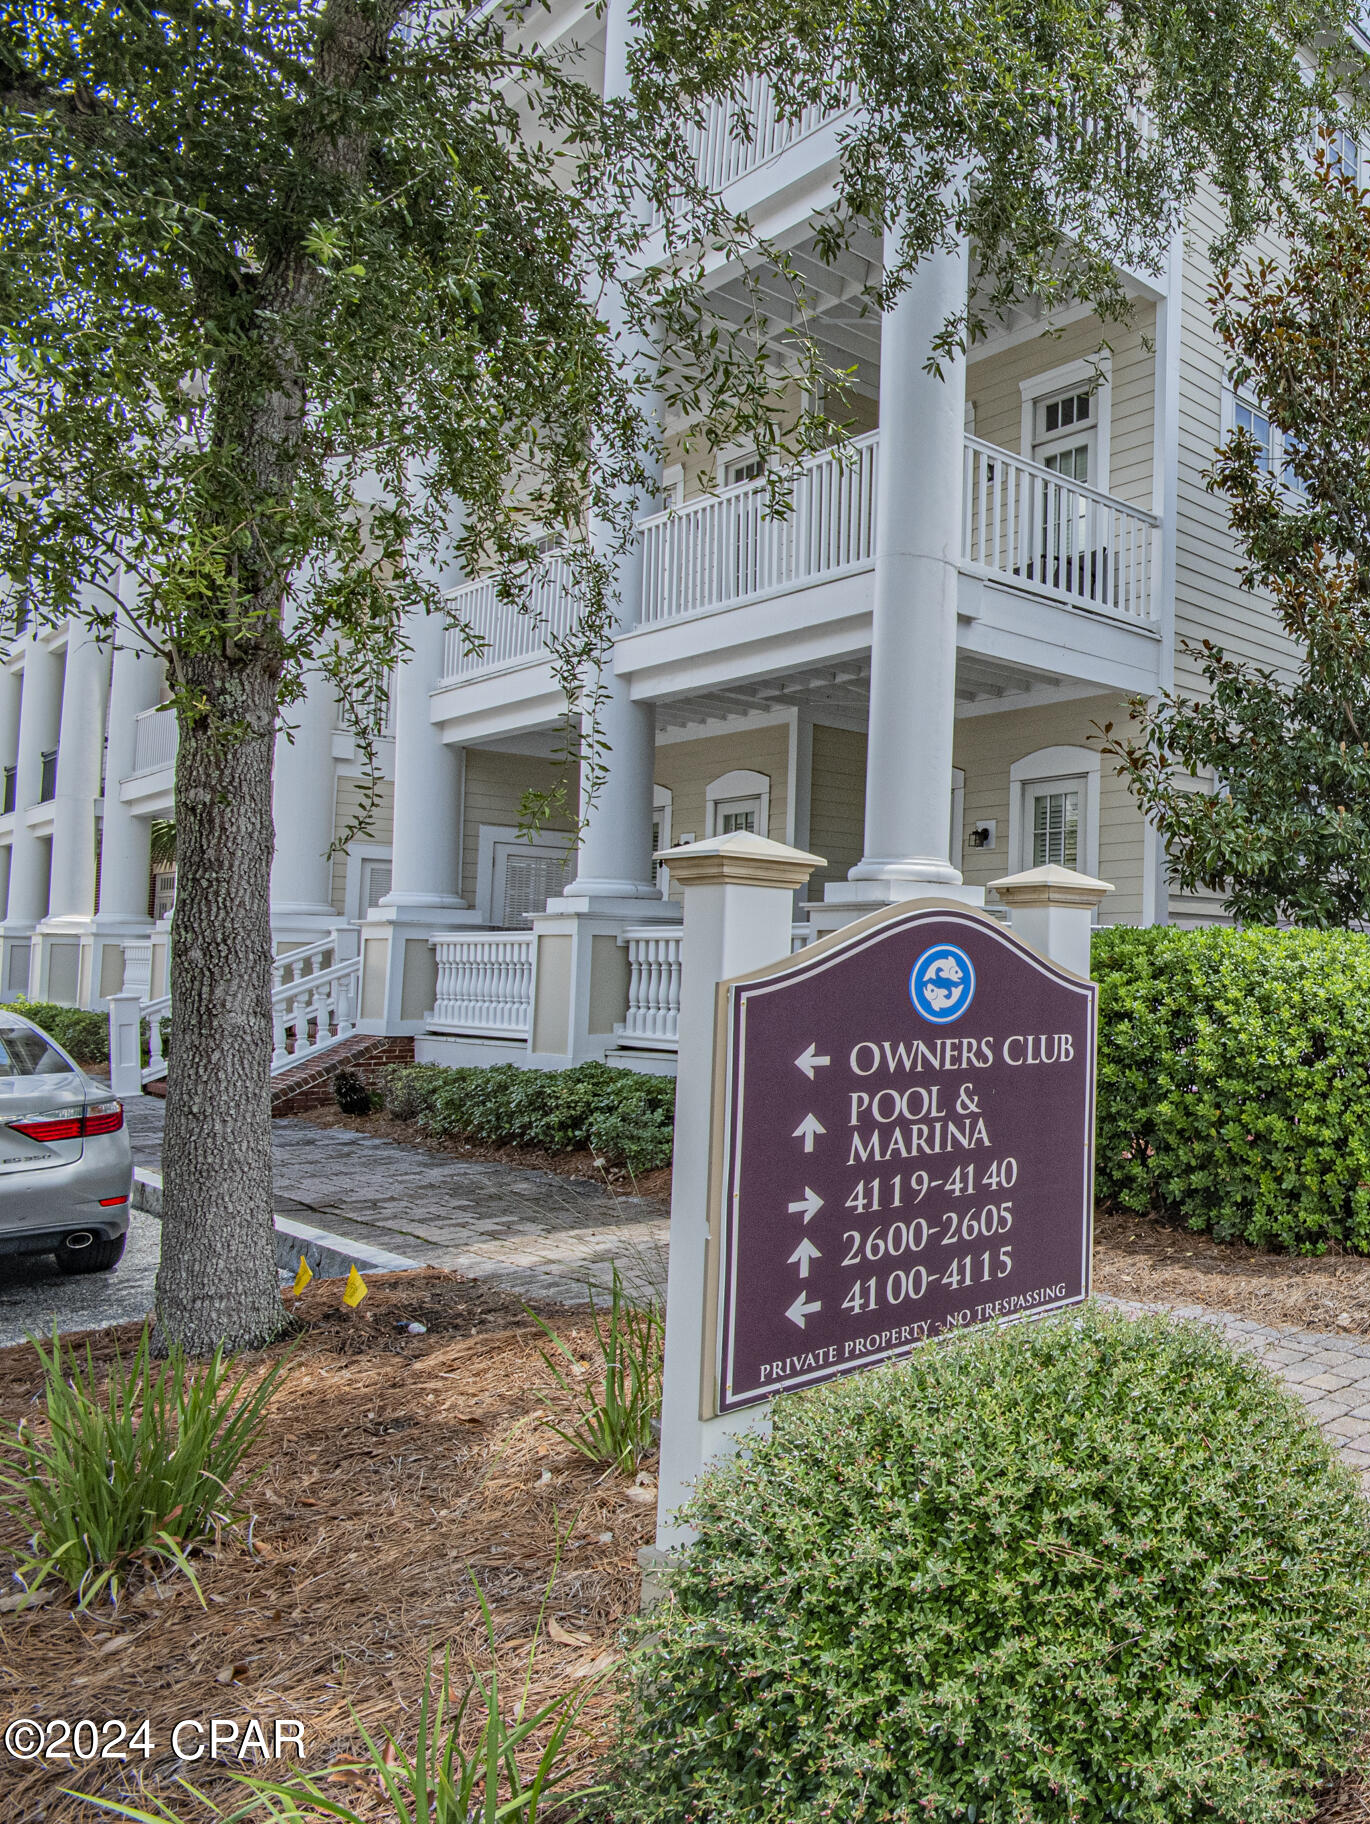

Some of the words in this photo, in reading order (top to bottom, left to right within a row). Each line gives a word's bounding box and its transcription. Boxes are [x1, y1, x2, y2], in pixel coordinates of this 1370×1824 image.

[849, 1036, 994, 1076] OWNERS
[1002, 1033, 1074, 1066] CLUB
[847, 1085, 946, 1126] POOL
[955, 1083, 982, 1115] &
[846, 1117, 993, 1166] MARINA
[844, 1157, 1018, 1214] 4119-4140
[840, 1201, 1013, 1267] 2600-2605
[841, 1245, 1012, 1315] 4100-4115
[759, 1345, 837, 1382] PRIVATE
[844, 1319, 931, 1358] PROPERTY
[946, 1309, 971, 1328] NO
[974, 1283, 1066, 1321] TRESPASSING
